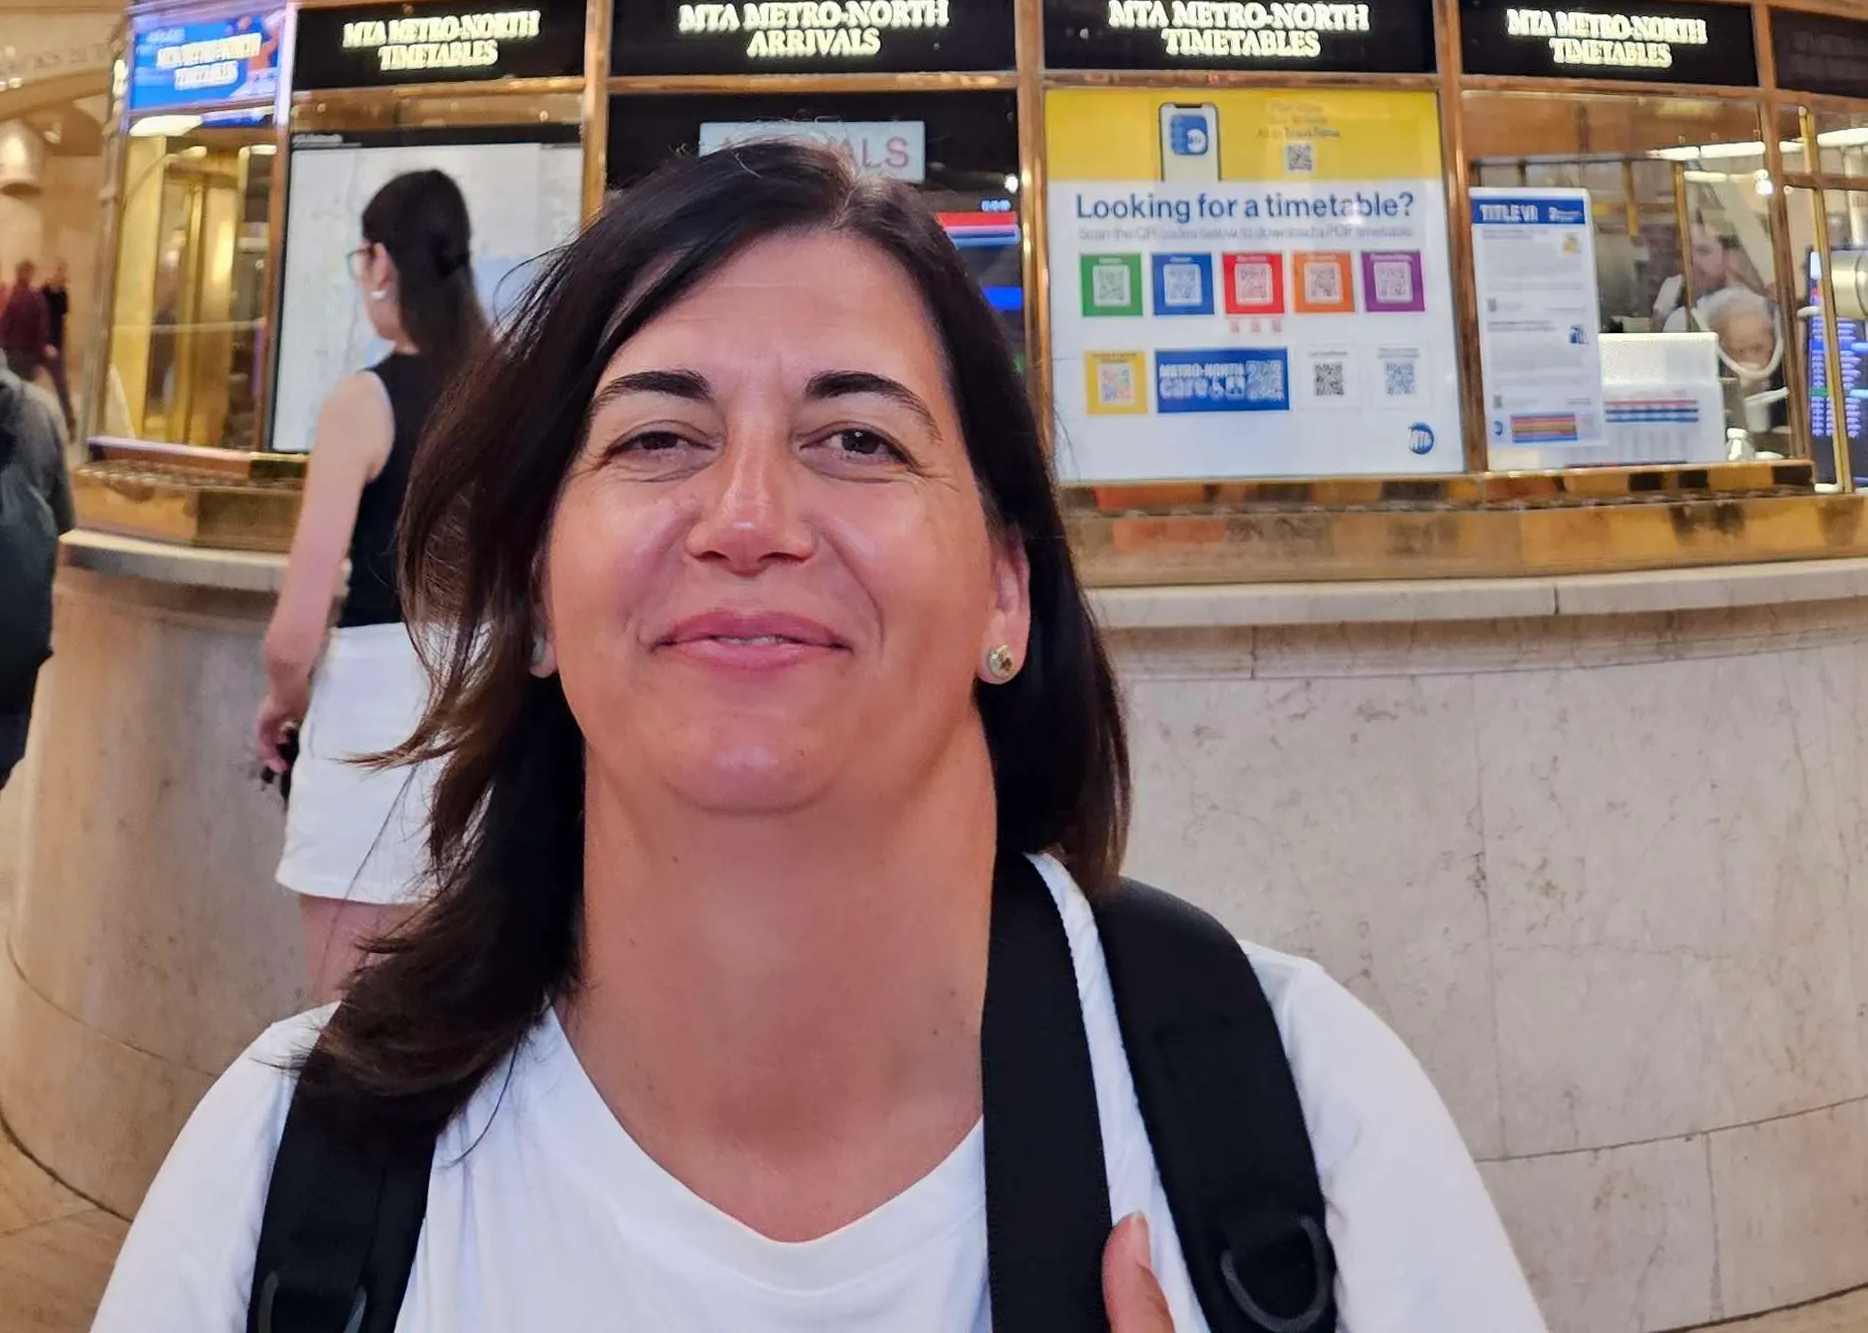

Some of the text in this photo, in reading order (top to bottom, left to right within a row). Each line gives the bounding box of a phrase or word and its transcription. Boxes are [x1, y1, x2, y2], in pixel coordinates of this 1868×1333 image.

[342, 9, 541, 48] MTA METRO-NORTH
[679, 3, 740, 33] MTA
[1108, 0, 1370, 31] MTA METRO-NORTH
[1506, 8, 1708, 45] MTA METRO-NORTH
[377, 39, 499, 71] TIMETABLES
[746, 27, 881, 58] ARRIVALS
[1161, 28, 1322, 58] TIMETABLES
[1548, 37, 1673, 69] TIMETABLES
[1076, 191, 1415, 223] Looking for a timetable?
[1479, 204, 1520, 222] TITLE
